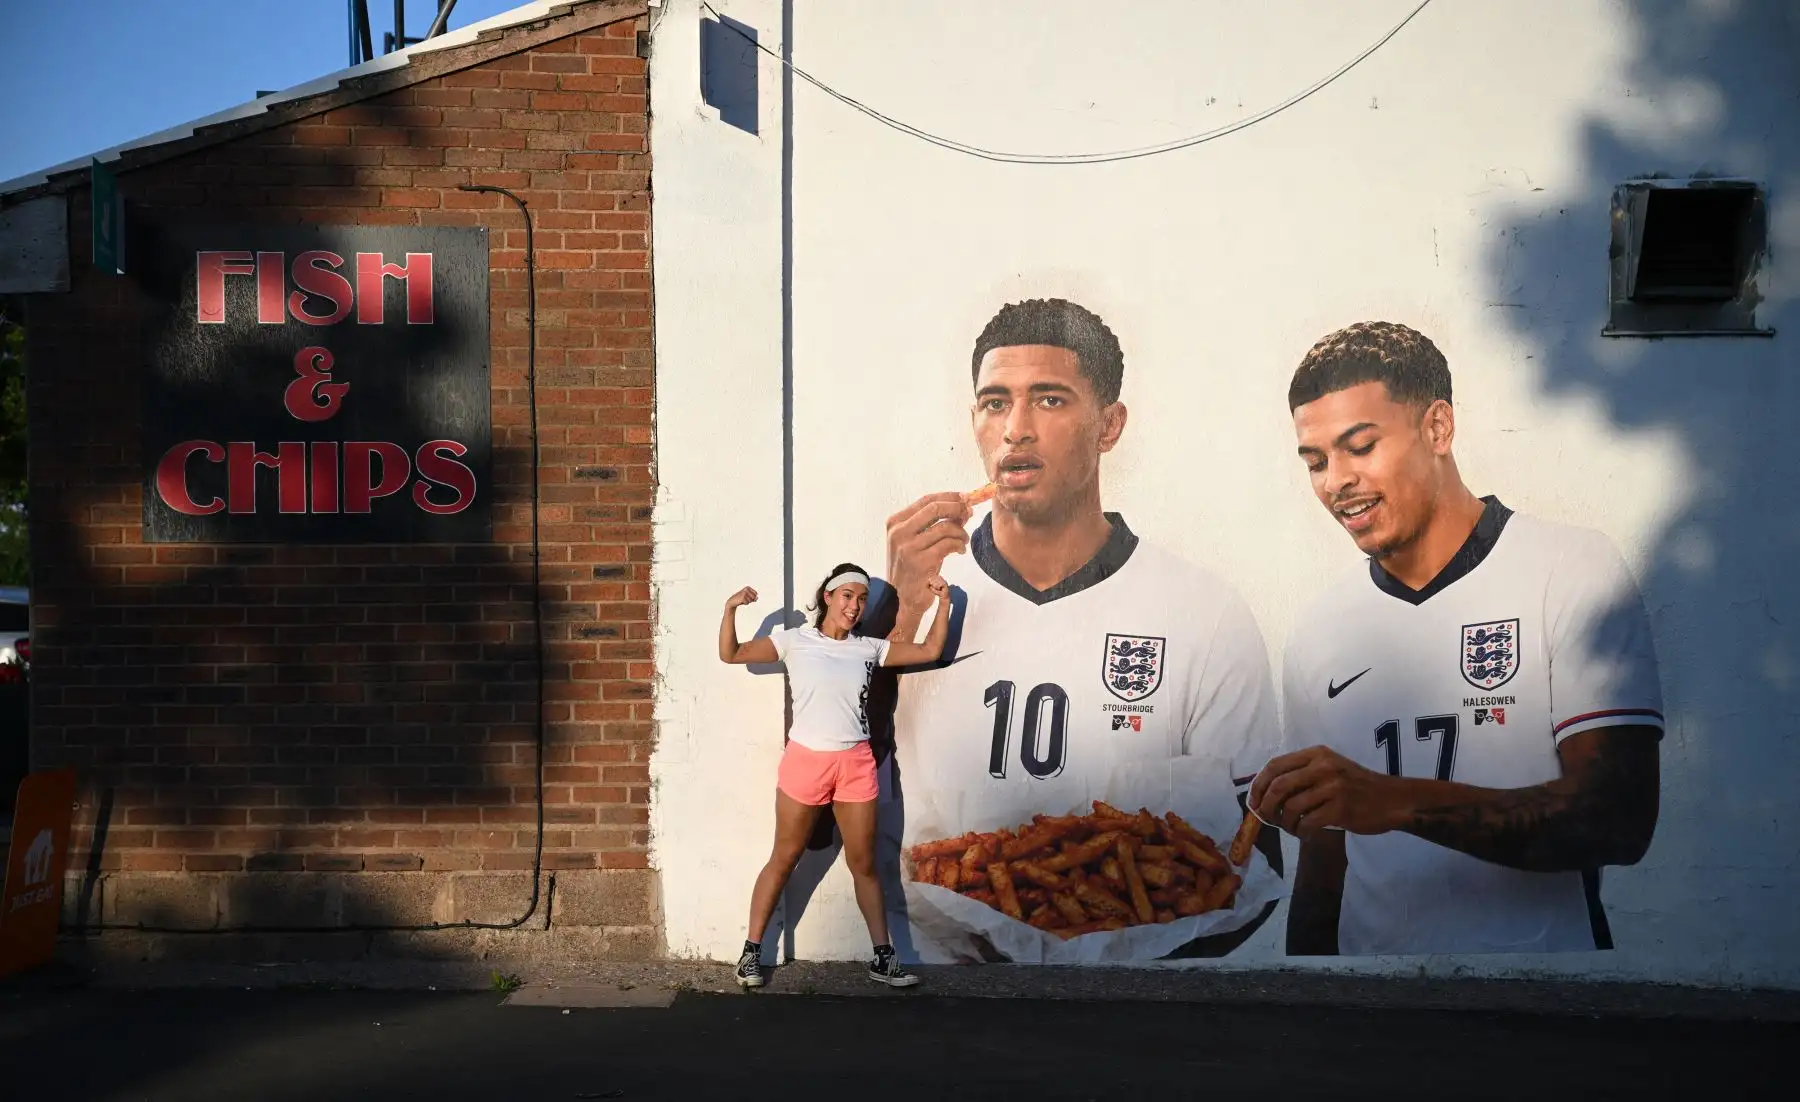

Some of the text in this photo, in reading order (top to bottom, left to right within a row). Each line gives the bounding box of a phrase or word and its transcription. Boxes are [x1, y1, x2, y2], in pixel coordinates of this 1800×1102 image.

[196, 250, 434, 325] FISH
[284, 346, 350, 422] &
[156, 439, 477, 515] CHIPS
[984, 680, 1069, 780] 10
[1102, 703, 1154, 714] STOURBRIDGE
[1463, 696, 1516, 707] HALESOWEN
[1375, 713, 1460, 781] 17
[10, 890, 36, 912] JUST
